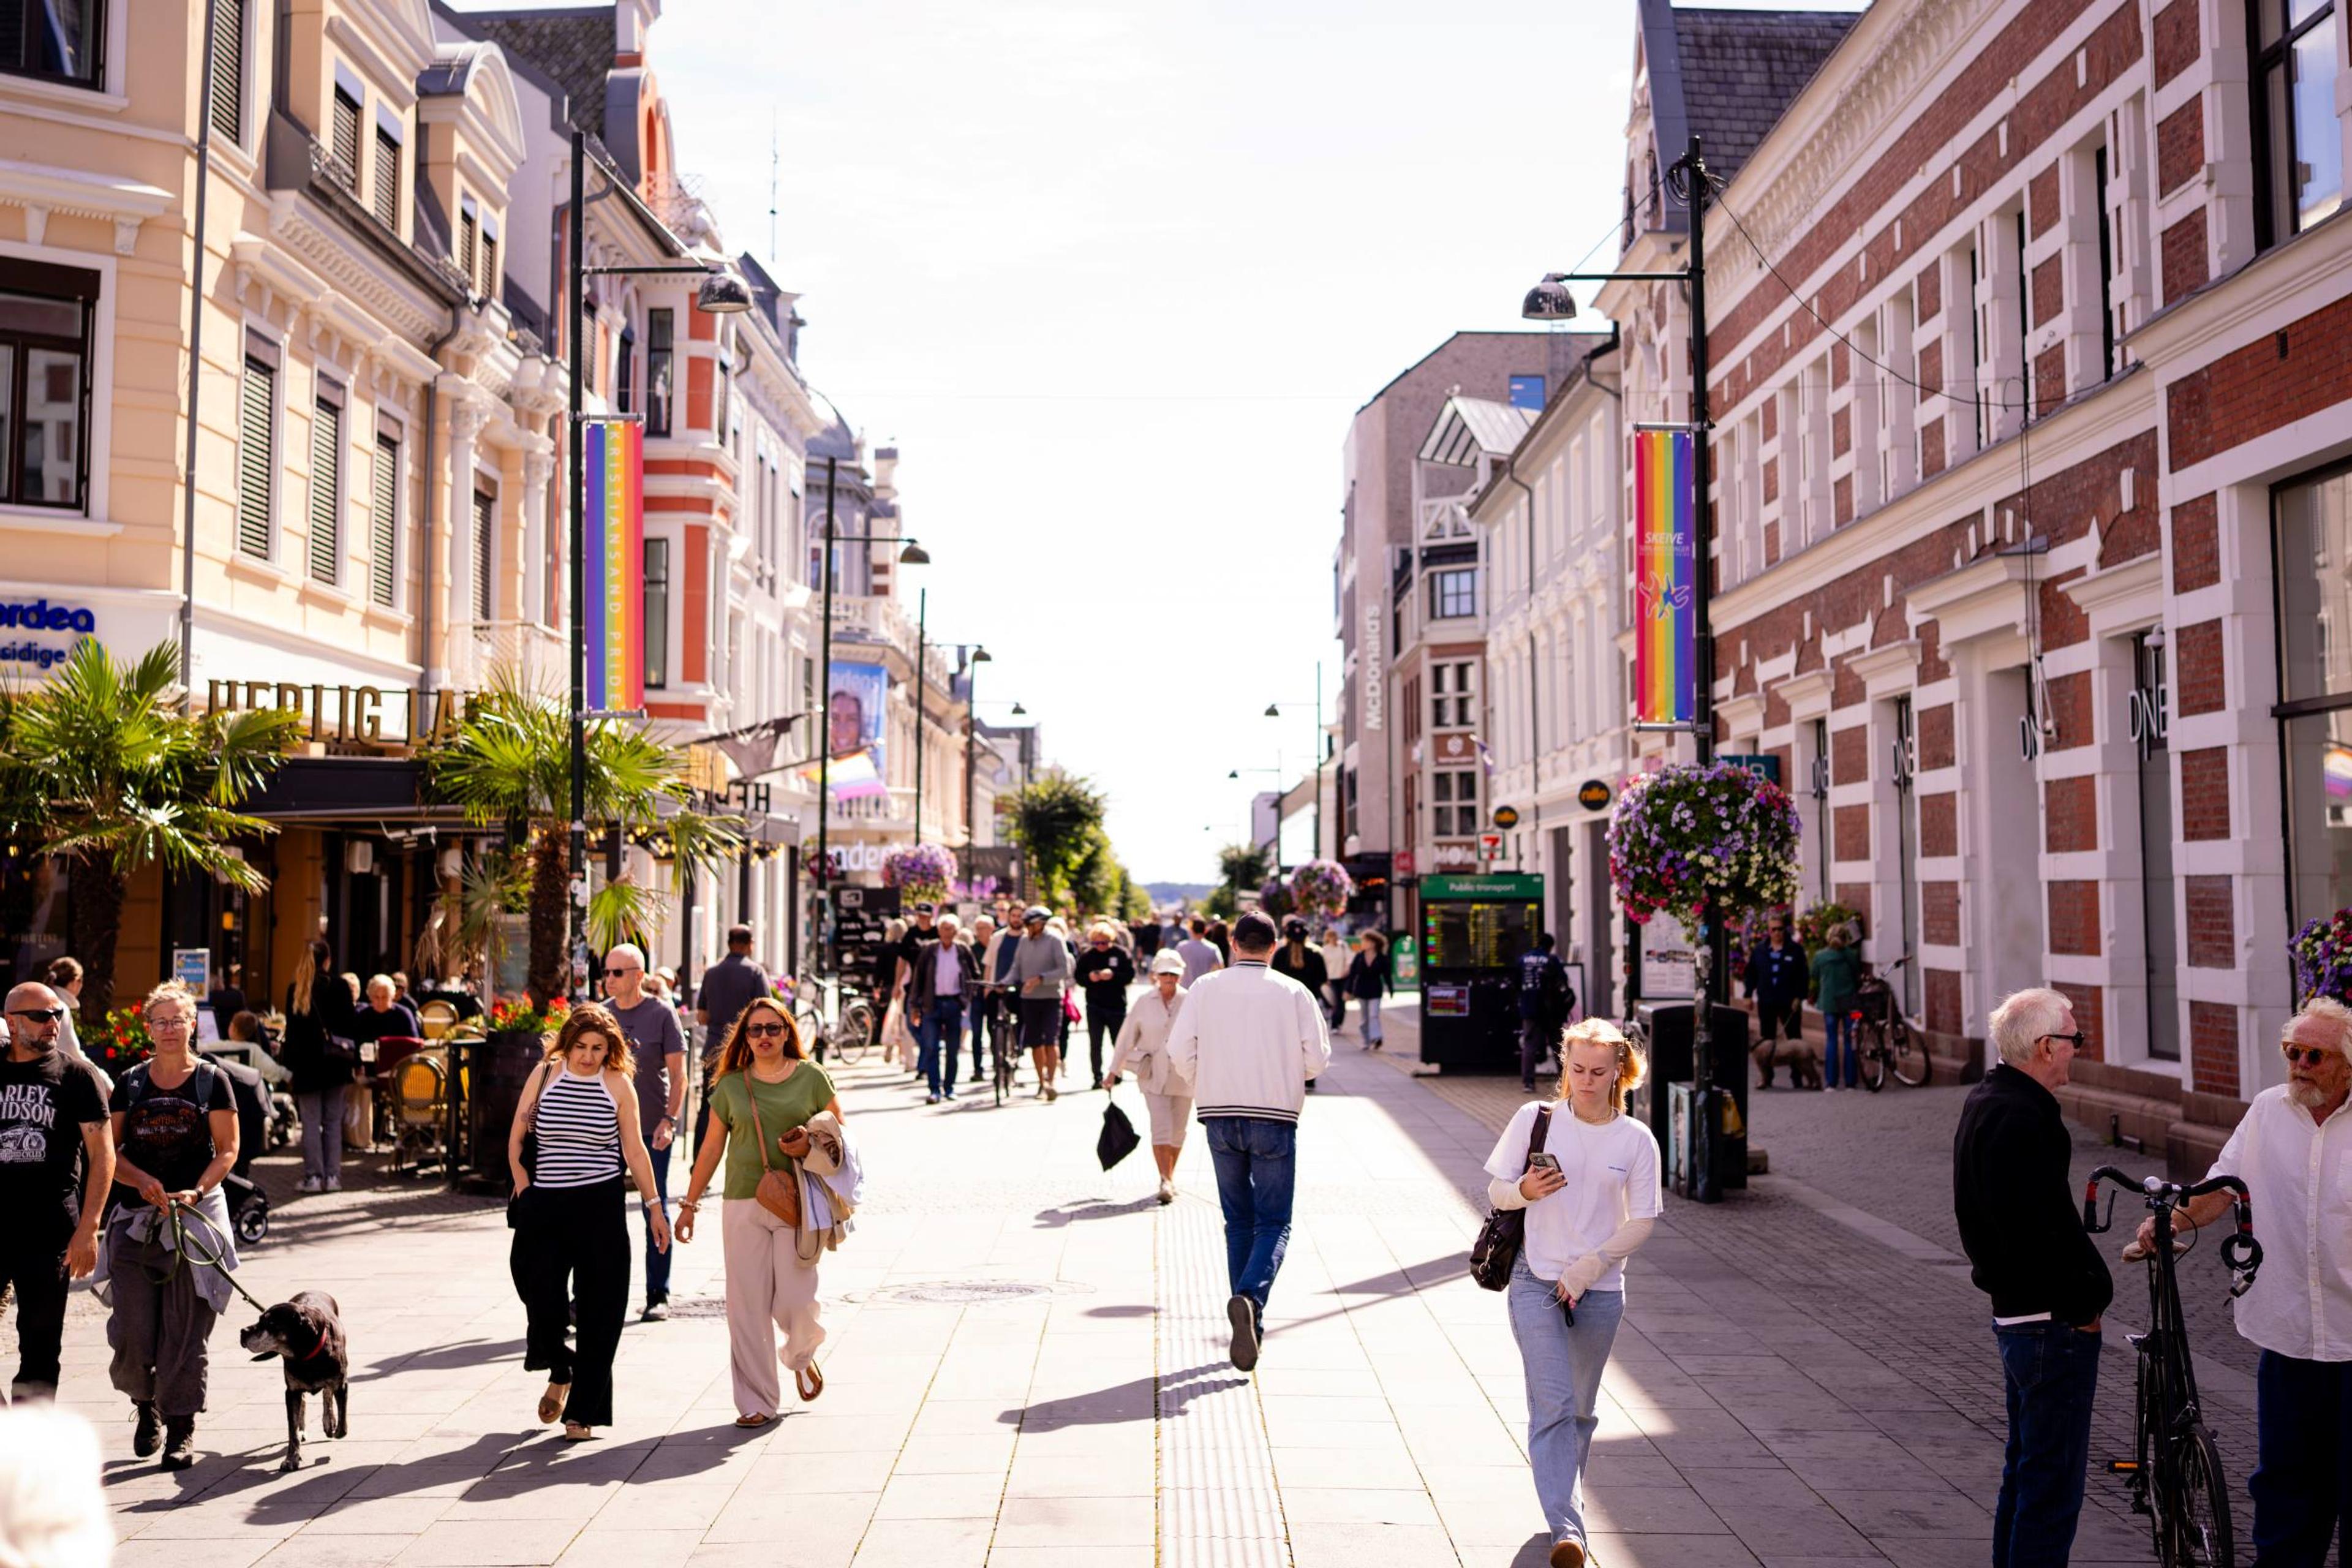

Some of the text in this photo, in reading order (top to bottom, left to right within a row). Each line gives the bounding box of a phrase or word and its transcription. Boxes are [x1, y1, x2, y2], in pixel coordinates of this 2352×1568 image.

[1645, 532, 1684, 545] SKEIVE
[609, 431, 622, 703] KRISTIANSAND PRIDE
[2020, 715, 2038, 761] DN
[1449, 882, 1516, 893] Public transport
[0, 1084, 53, 1105] RLEY-
